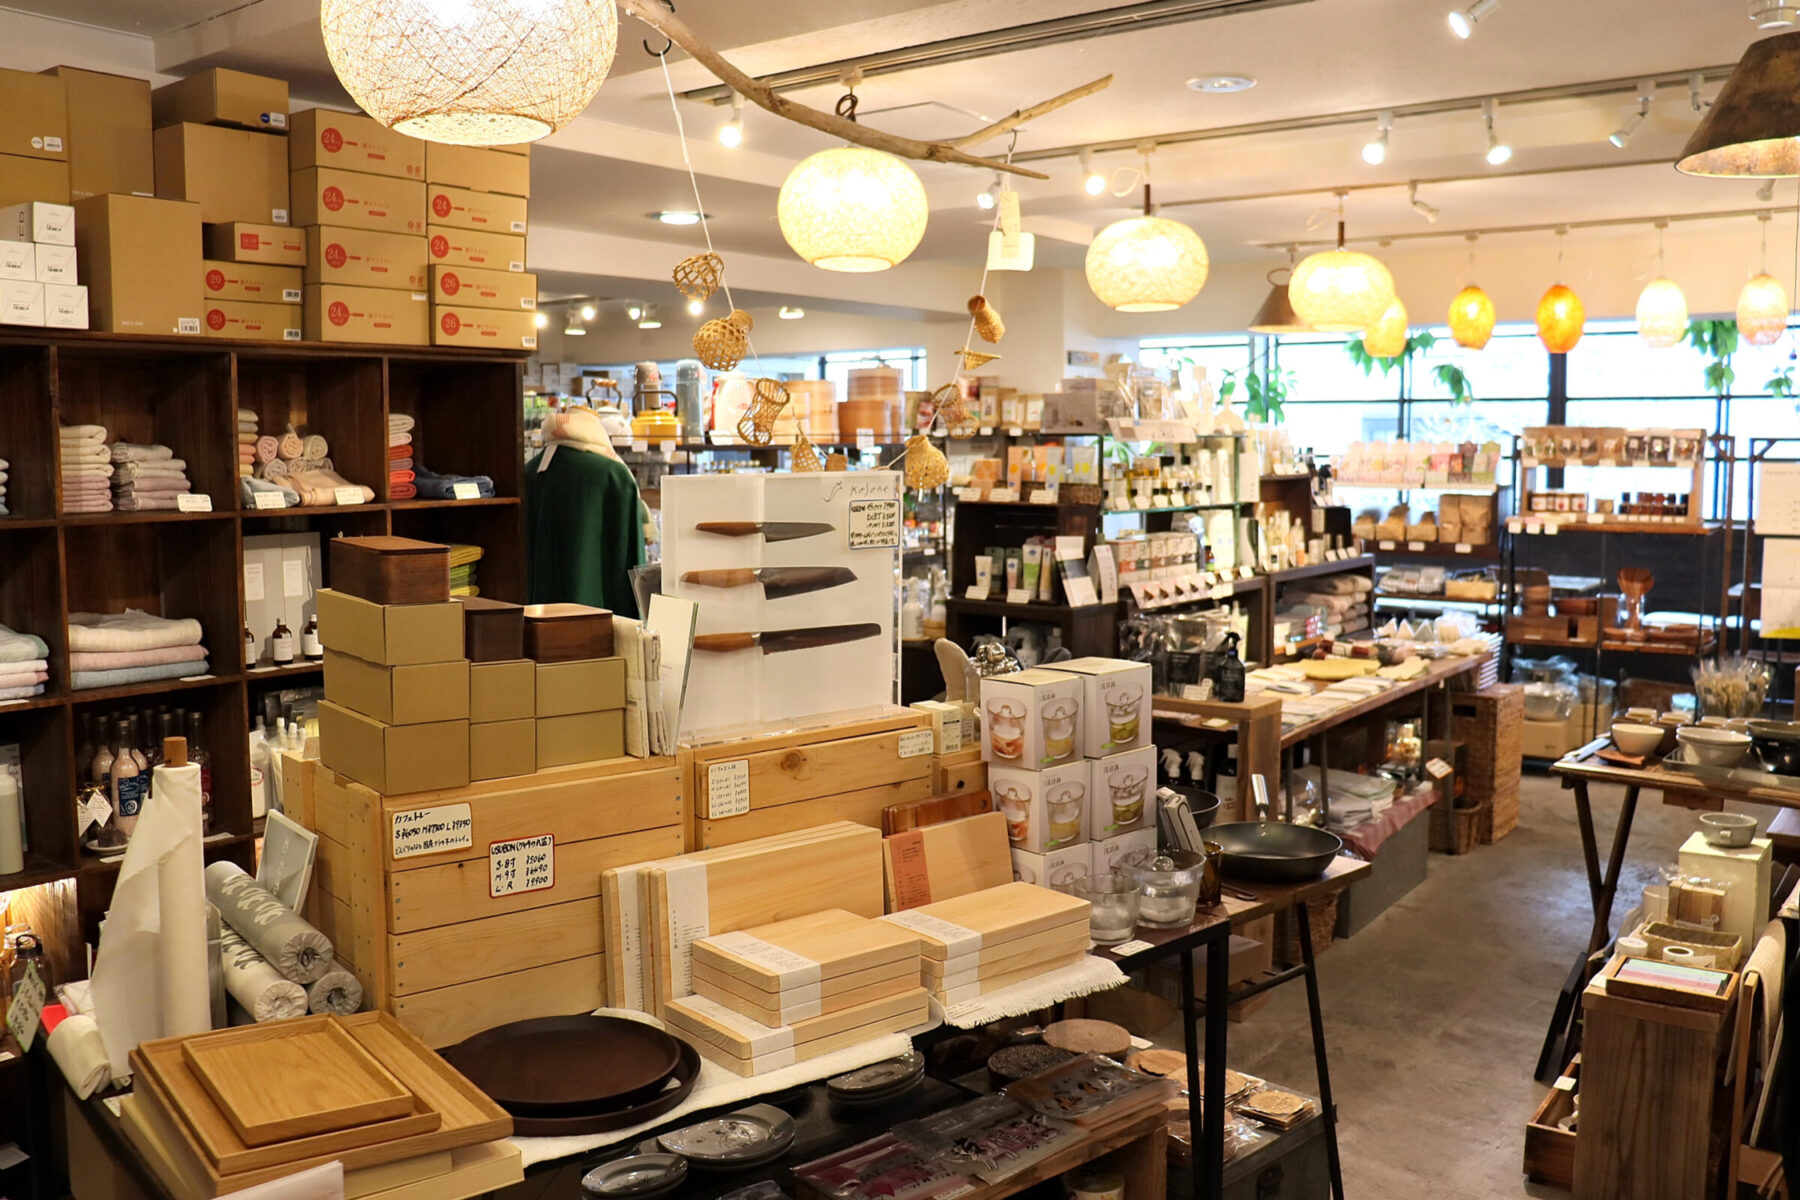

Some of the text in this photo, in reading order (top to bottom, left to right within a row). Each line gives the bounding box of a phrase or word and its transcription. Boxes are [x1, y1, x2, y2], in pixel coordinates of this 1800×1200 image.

[395, 811, 431, 824] カフェトレー
